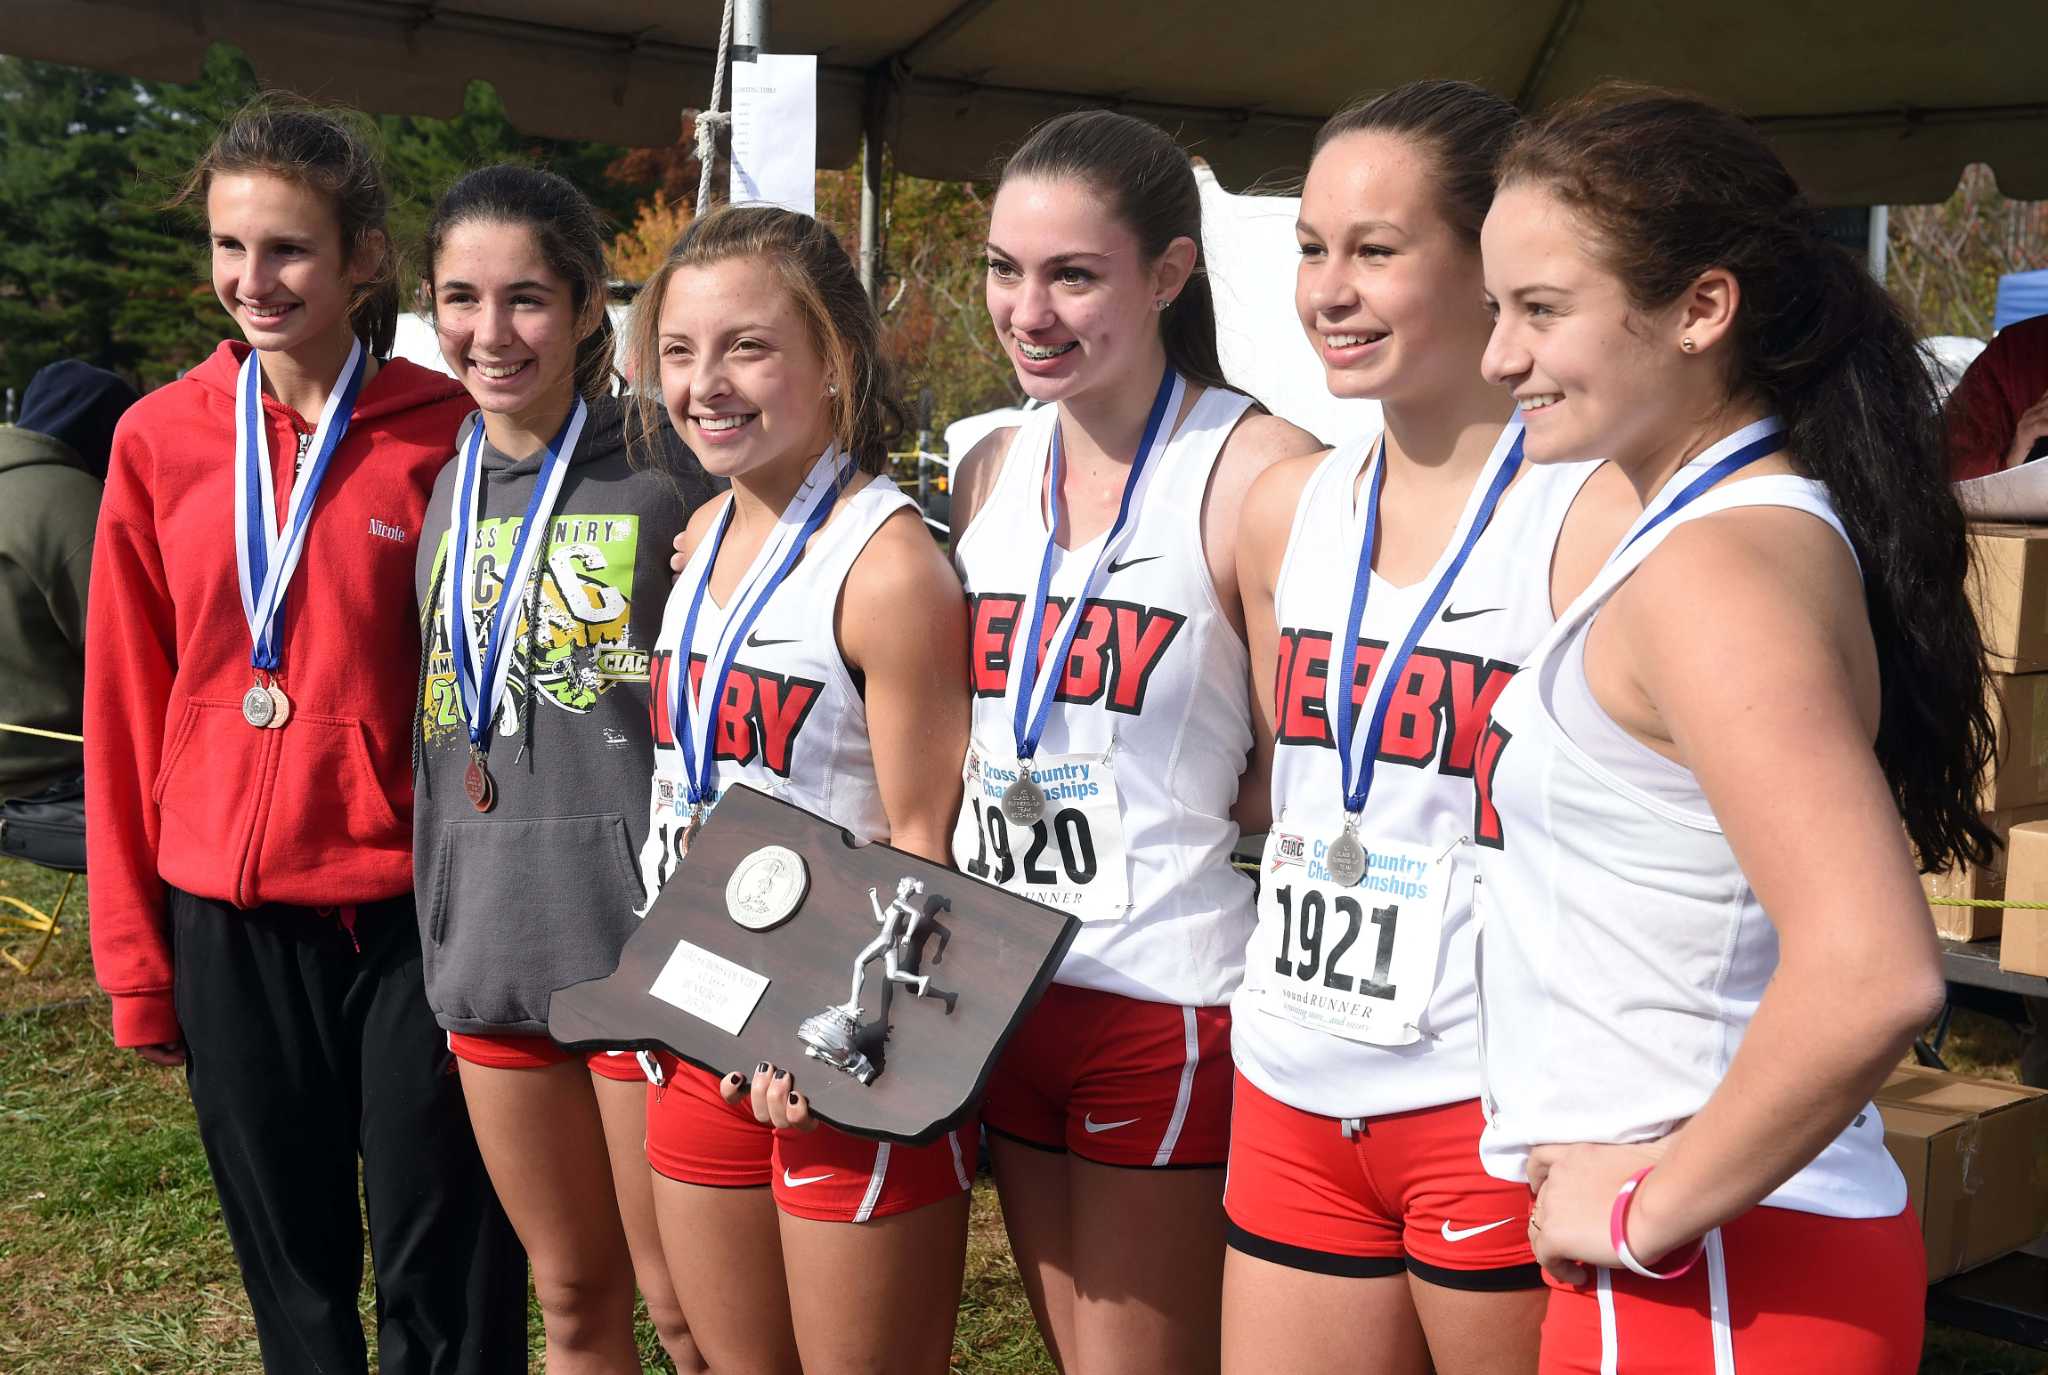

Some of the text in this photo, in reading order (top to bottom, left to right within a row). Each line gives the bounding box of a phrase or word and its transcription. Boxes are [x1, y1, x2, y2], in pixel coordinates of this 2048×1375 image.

[368, 518, 405, 543] Nicole
[604, 655, 649, 673] CIAC
[984, 760, 1018, 783] Cross
[1031, 762, 1089, 784] ountry
[967, 797, 1097, 885] 1920
[1280, 839, 1305, 857] CIAC
[1367, 853, 1428, 880] ountry
[1275, 885, 1399, 1001] 1921
